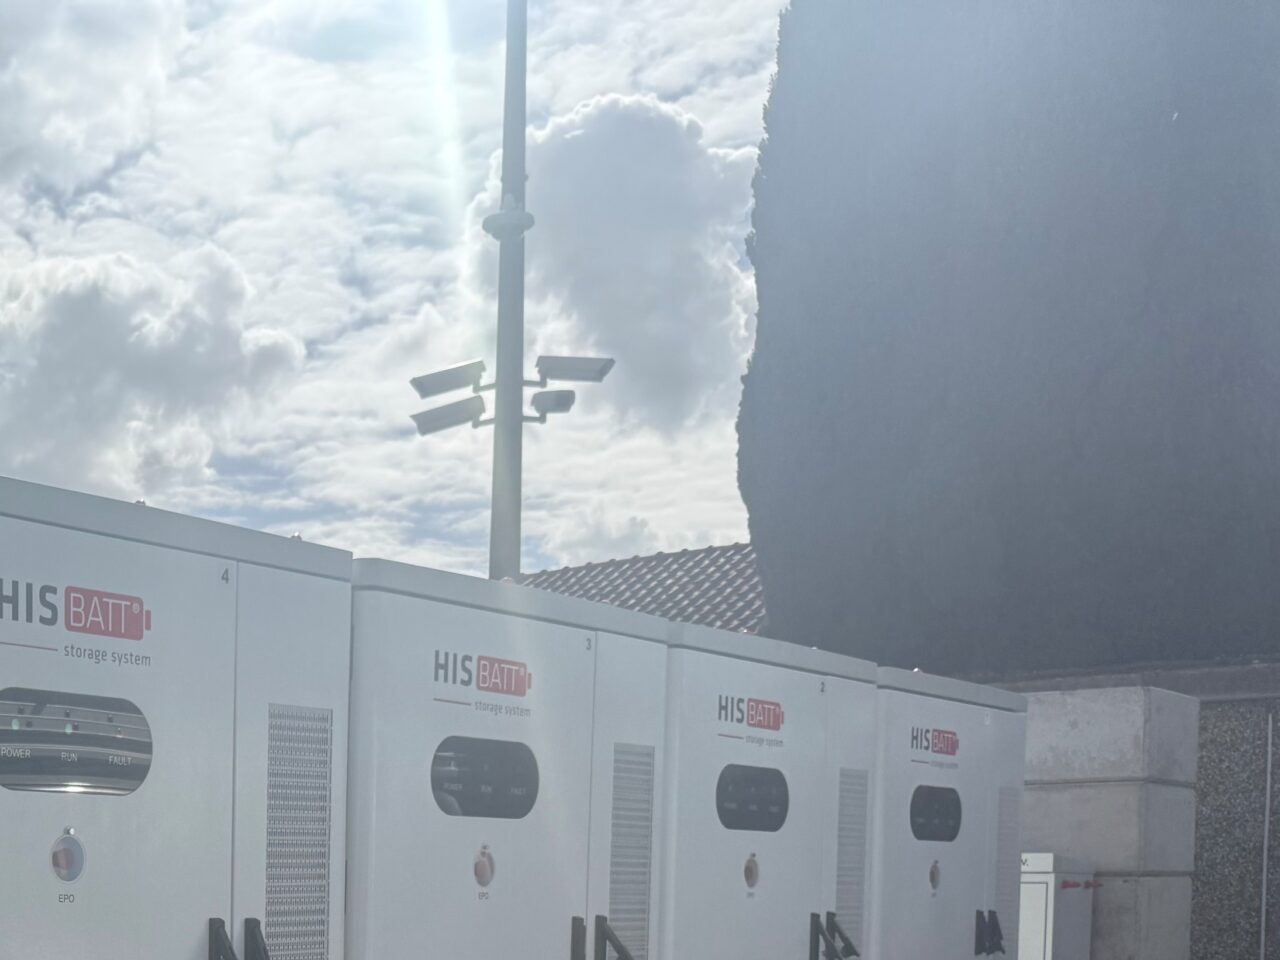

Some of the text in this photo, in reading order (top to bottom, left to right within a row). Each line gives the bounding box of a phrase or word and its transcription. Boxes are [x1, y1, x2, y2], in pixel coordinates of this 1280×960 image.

[221, 568, 230, 584] 4
[63, 643, 152, 667] storage system
[585, 638, 592, 650] 3
[433, 650, 473, 687] HIS
[718, 695, 745, 724] HIS
[911, 727, 930, 751] HIS
[0, 747, 133, 767] POWER RUN FAULT
[58, 894, 75, 903] EPO
